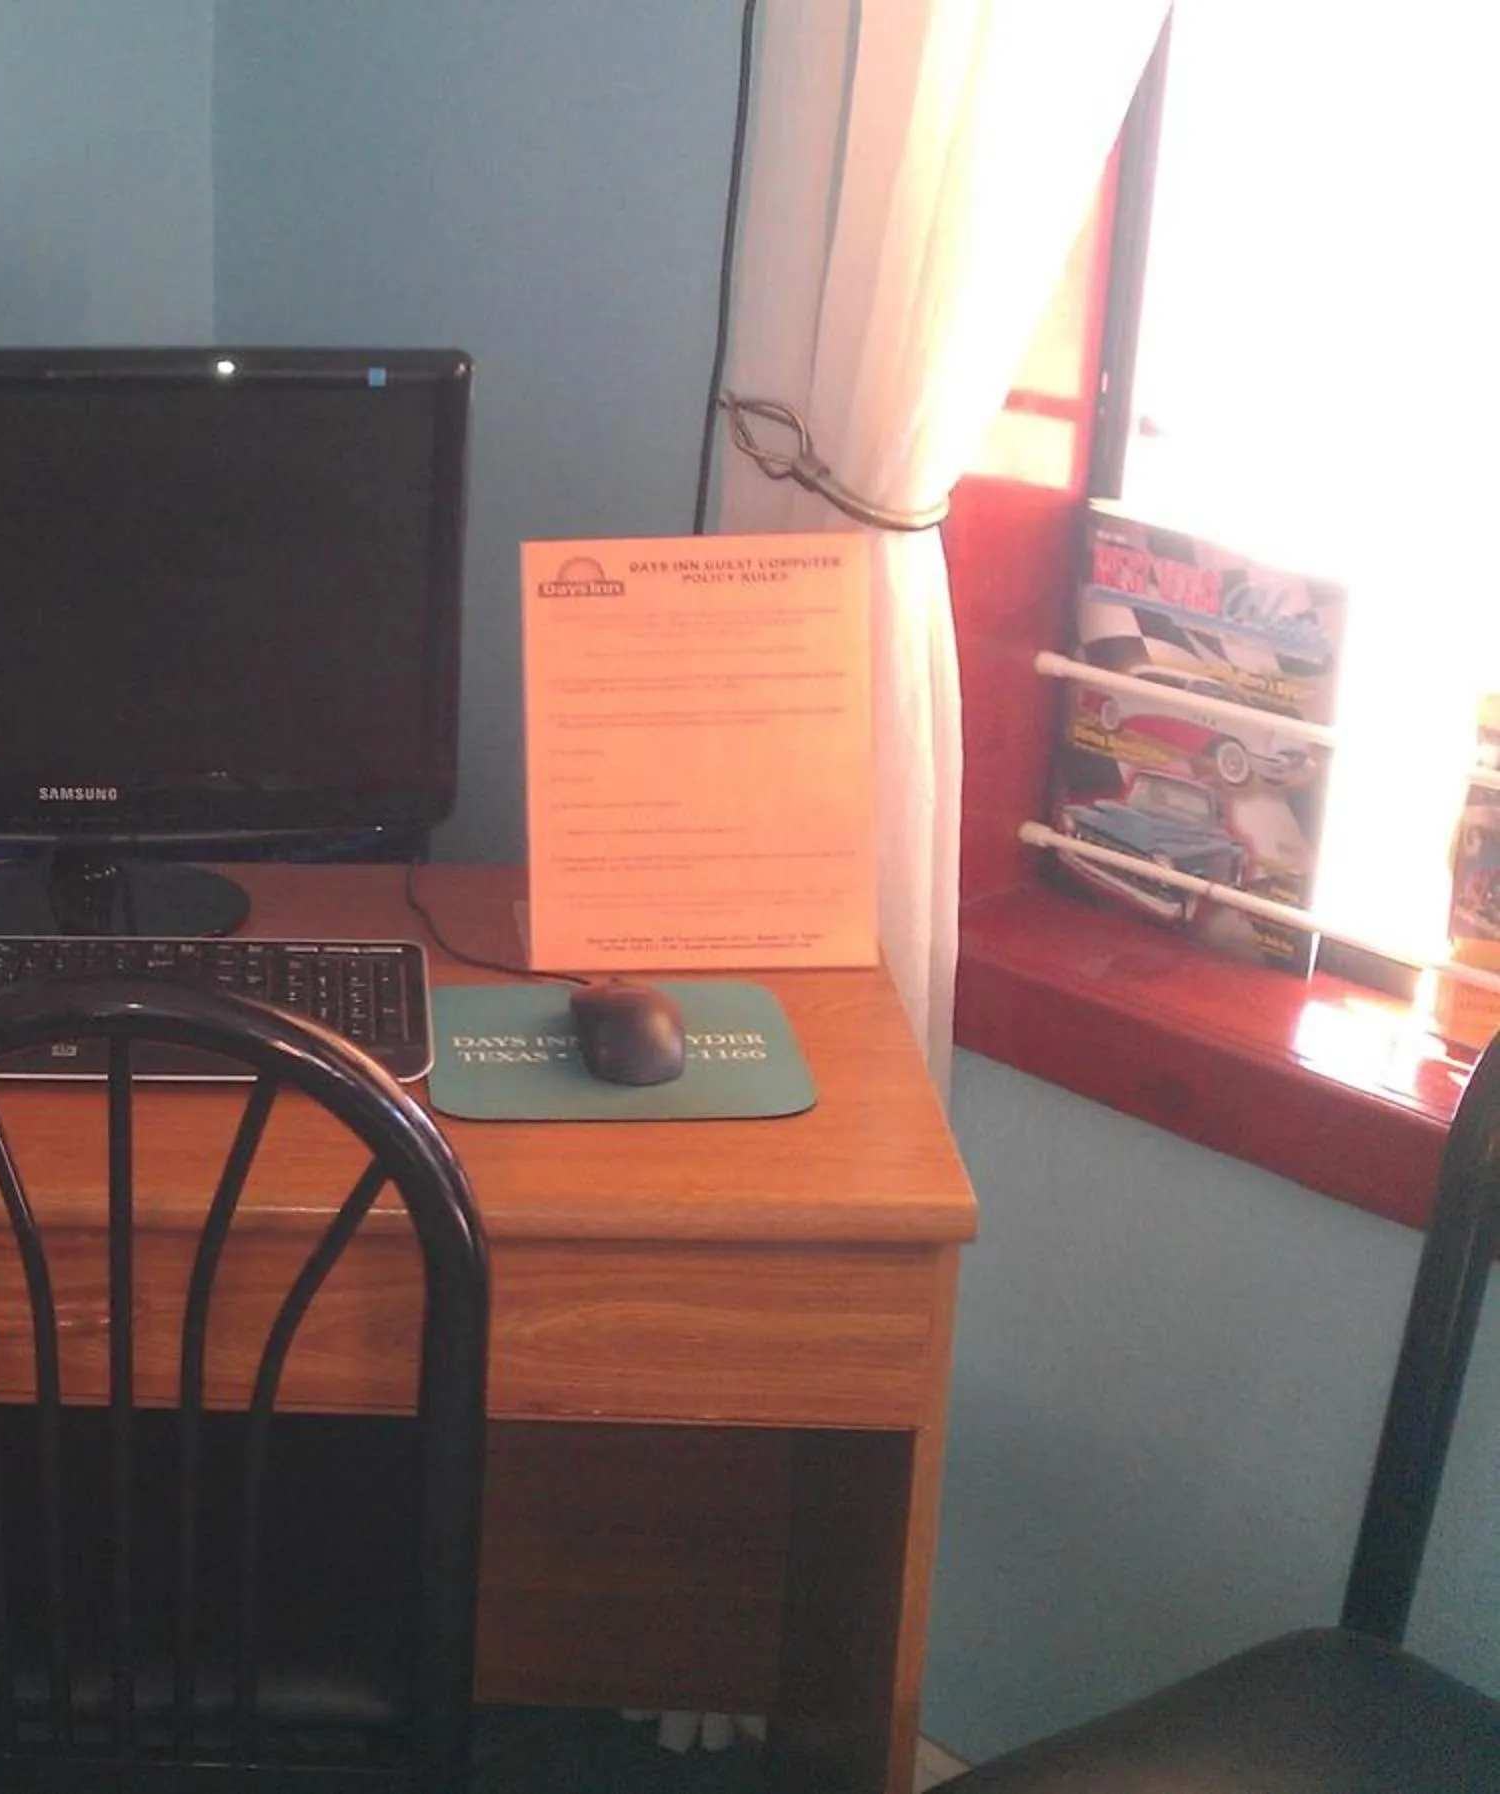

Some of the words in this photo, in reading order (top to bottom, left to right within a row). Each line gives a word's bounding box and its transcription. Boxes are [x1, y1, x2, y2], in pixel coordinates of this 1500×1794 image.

[38, 787, 118, 801] SAMSUNG
[452, 1035, 527, 1048] DAYS
[685, 1033, 766, 1046] YDER
[458, 1051, 549, 1063] TEXAS
[686, 1049, 767, 1060] -1166
